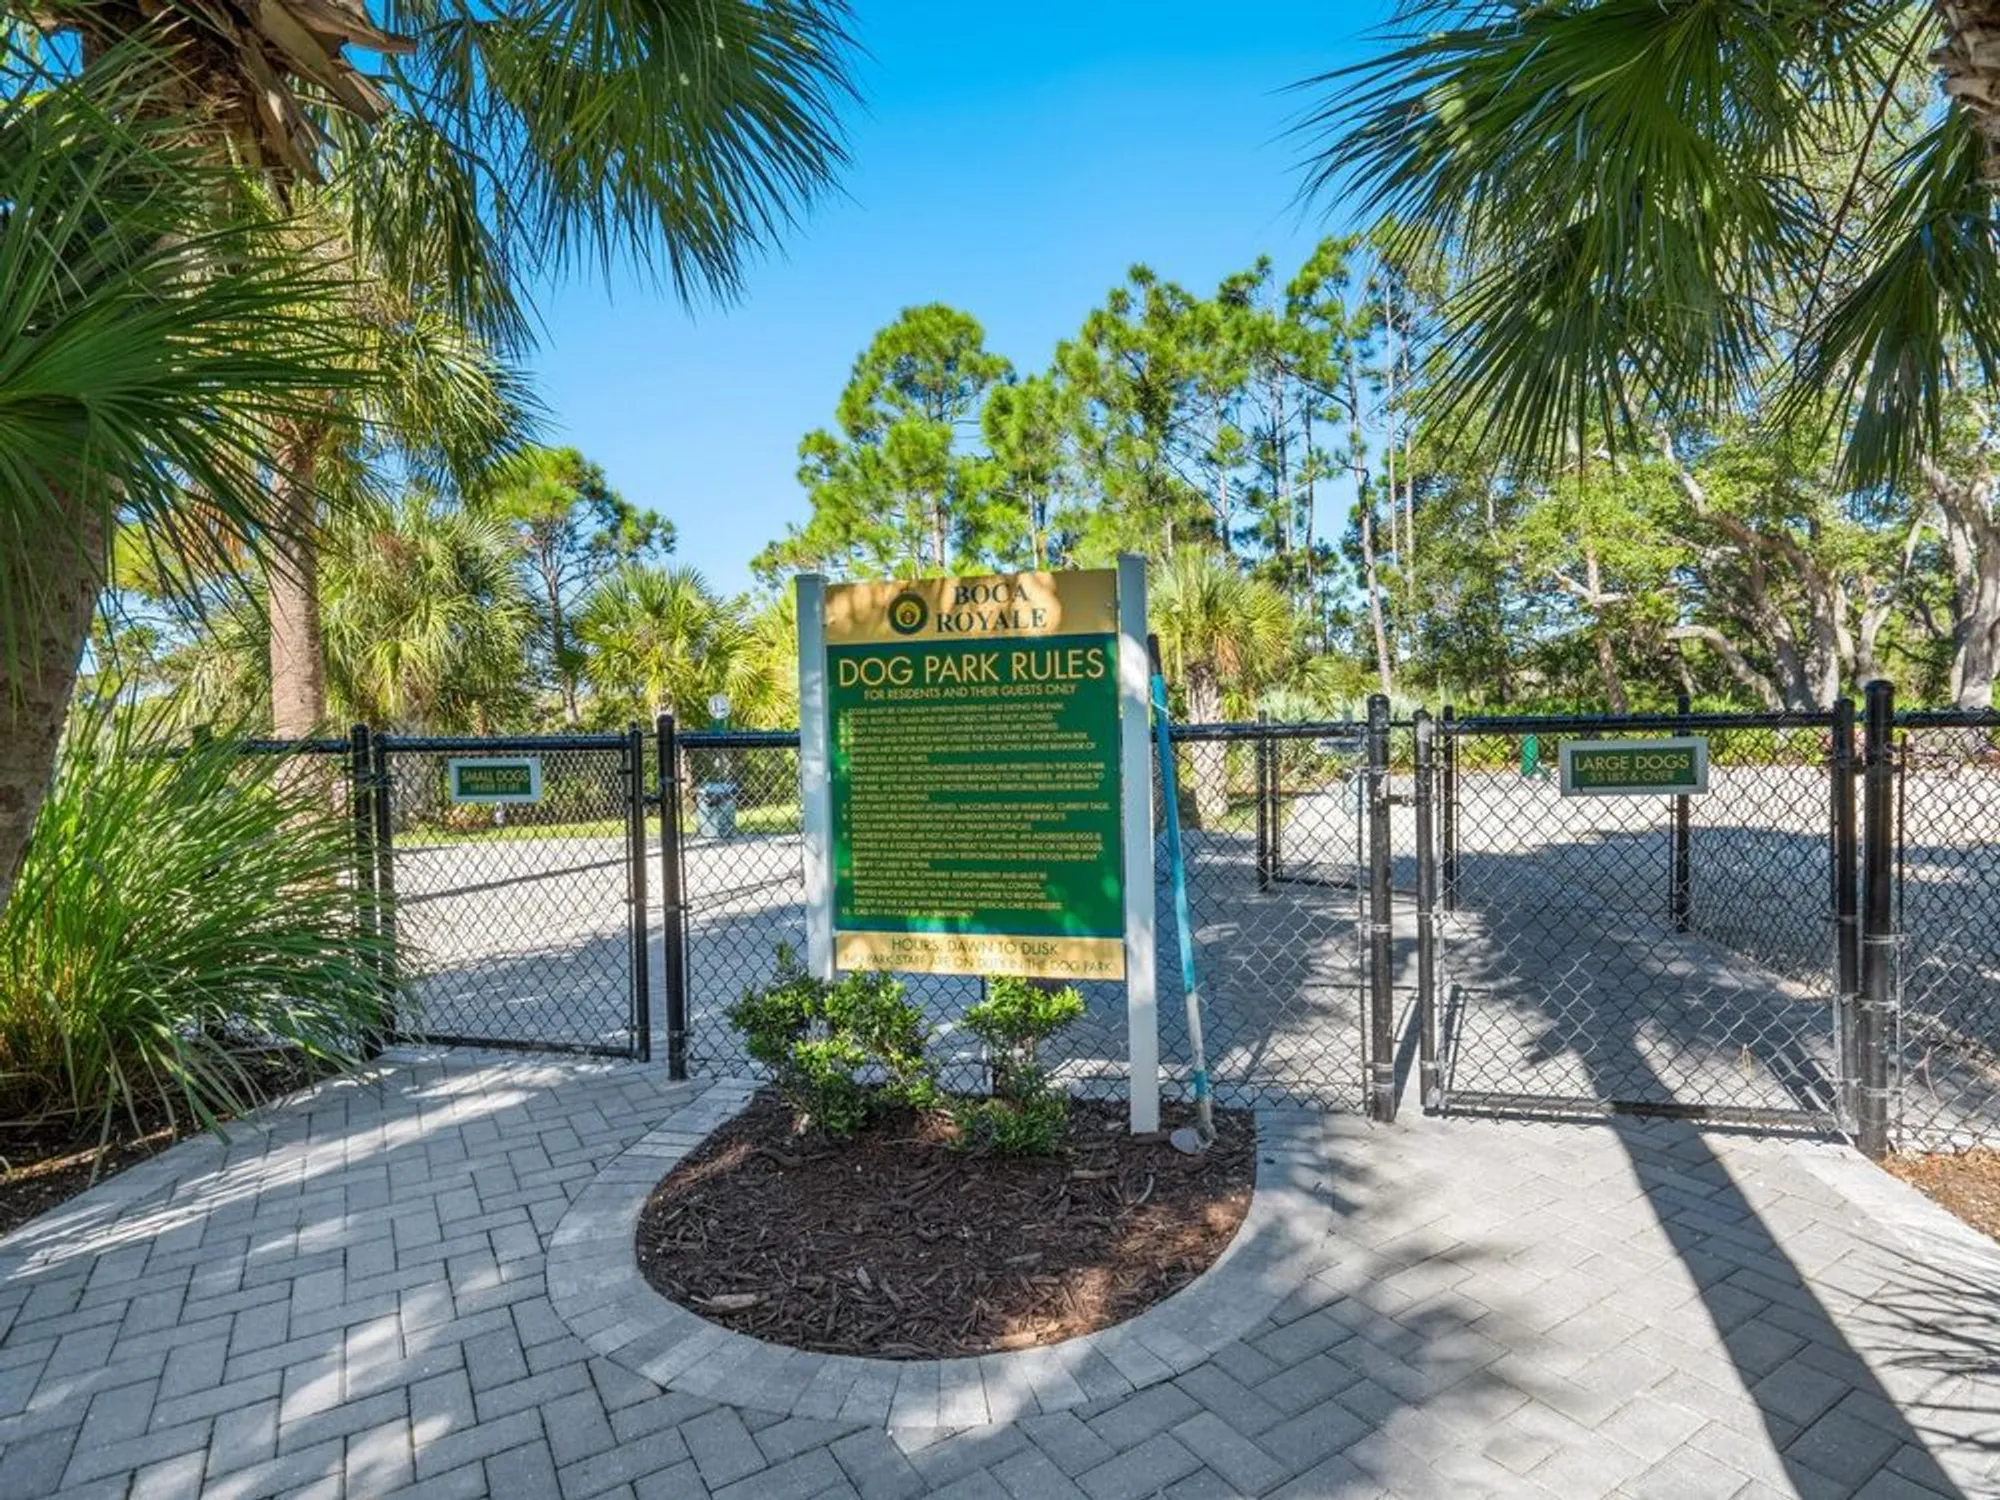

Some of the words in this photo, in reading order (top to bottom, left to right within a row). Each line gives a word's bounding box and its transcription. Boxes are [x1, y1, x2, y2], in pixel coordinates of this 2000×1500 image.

[954, 584, 1028, 605] BOCA
[936, 608, 1047, 633] ROYALE
[839, 656, 914, 686] DOG
[925, 652, 1000, 684] PARK
[1012, 648, 1105, 680] RULES
[864, 690, 885, 700] FOR
[888, 688, 941, 700] RESIDENTS
[944, 688, 968, 698] AND
[970, 687, 997, 698] THEIR
[1000, 686, 1041, 696] GUESTS
[1044, 684, 1076, 695] ONLY
[1575, 756, 1629, 772] LARGE
[1636, 754, 1690, 770] DOGS
[462, 770, 494, 784] SMALL
[496, 770, 529, 784] DOGS
[1607, 771, 1627, 782] LBS
[1630, 771, 1639, 781] &
[1642, 770, 1675, 782] OVER
[948, 940, 994, 953] DAWN
[998, 942, 1016, 954] TO
[1021, 942, 1058, 955] DUSK
[896, 954, 926, 965] STAFF
[954, 957, 973, 967] ON
[1024, 958, 1048, 970] THE
[1050, 960, 1080, 971] DOG
[1082, 960, 1112, 972] PARK
